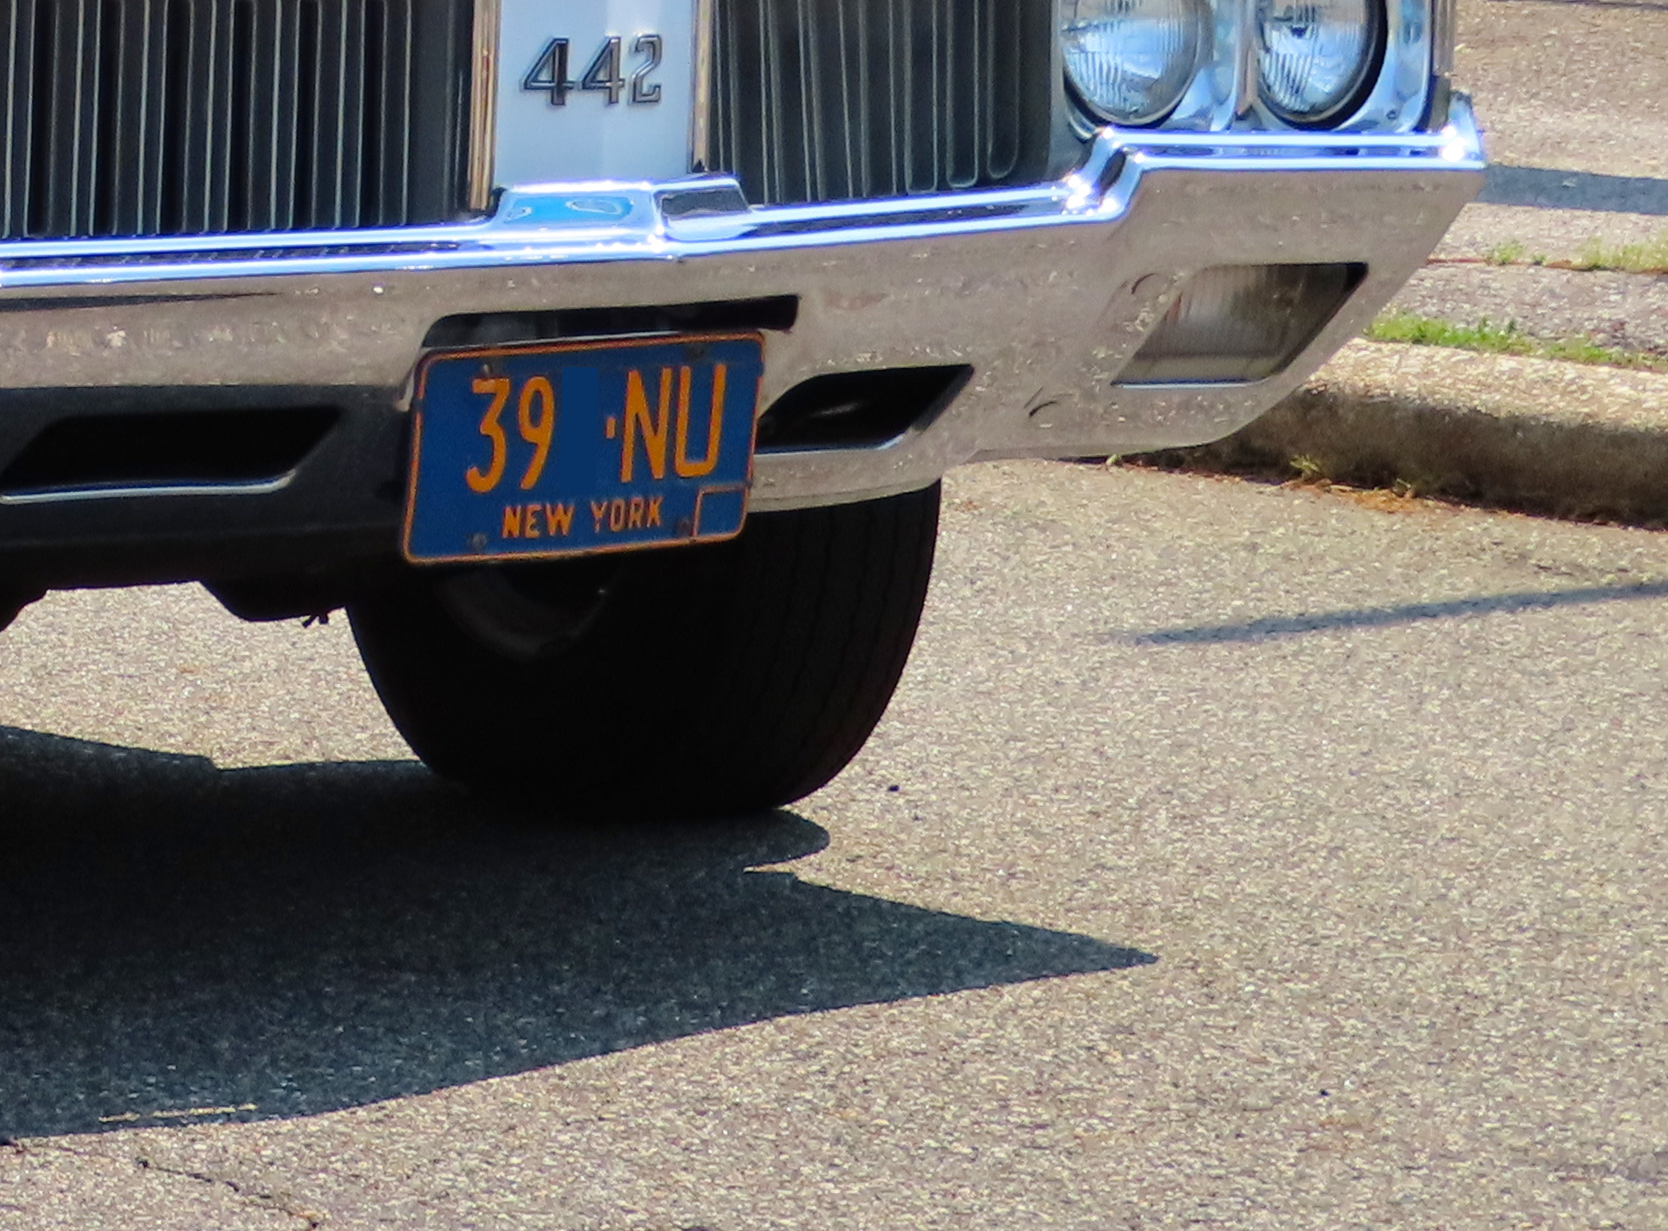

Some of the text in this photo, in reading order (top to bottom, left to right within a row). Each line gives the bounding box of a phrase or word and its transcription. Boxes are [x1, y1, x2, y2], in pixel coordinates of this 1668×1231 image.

[520, 34, 662, 107] 442
[466, 376, 555, 493] 39
[501, 496, 663, 539] NEW YORK
